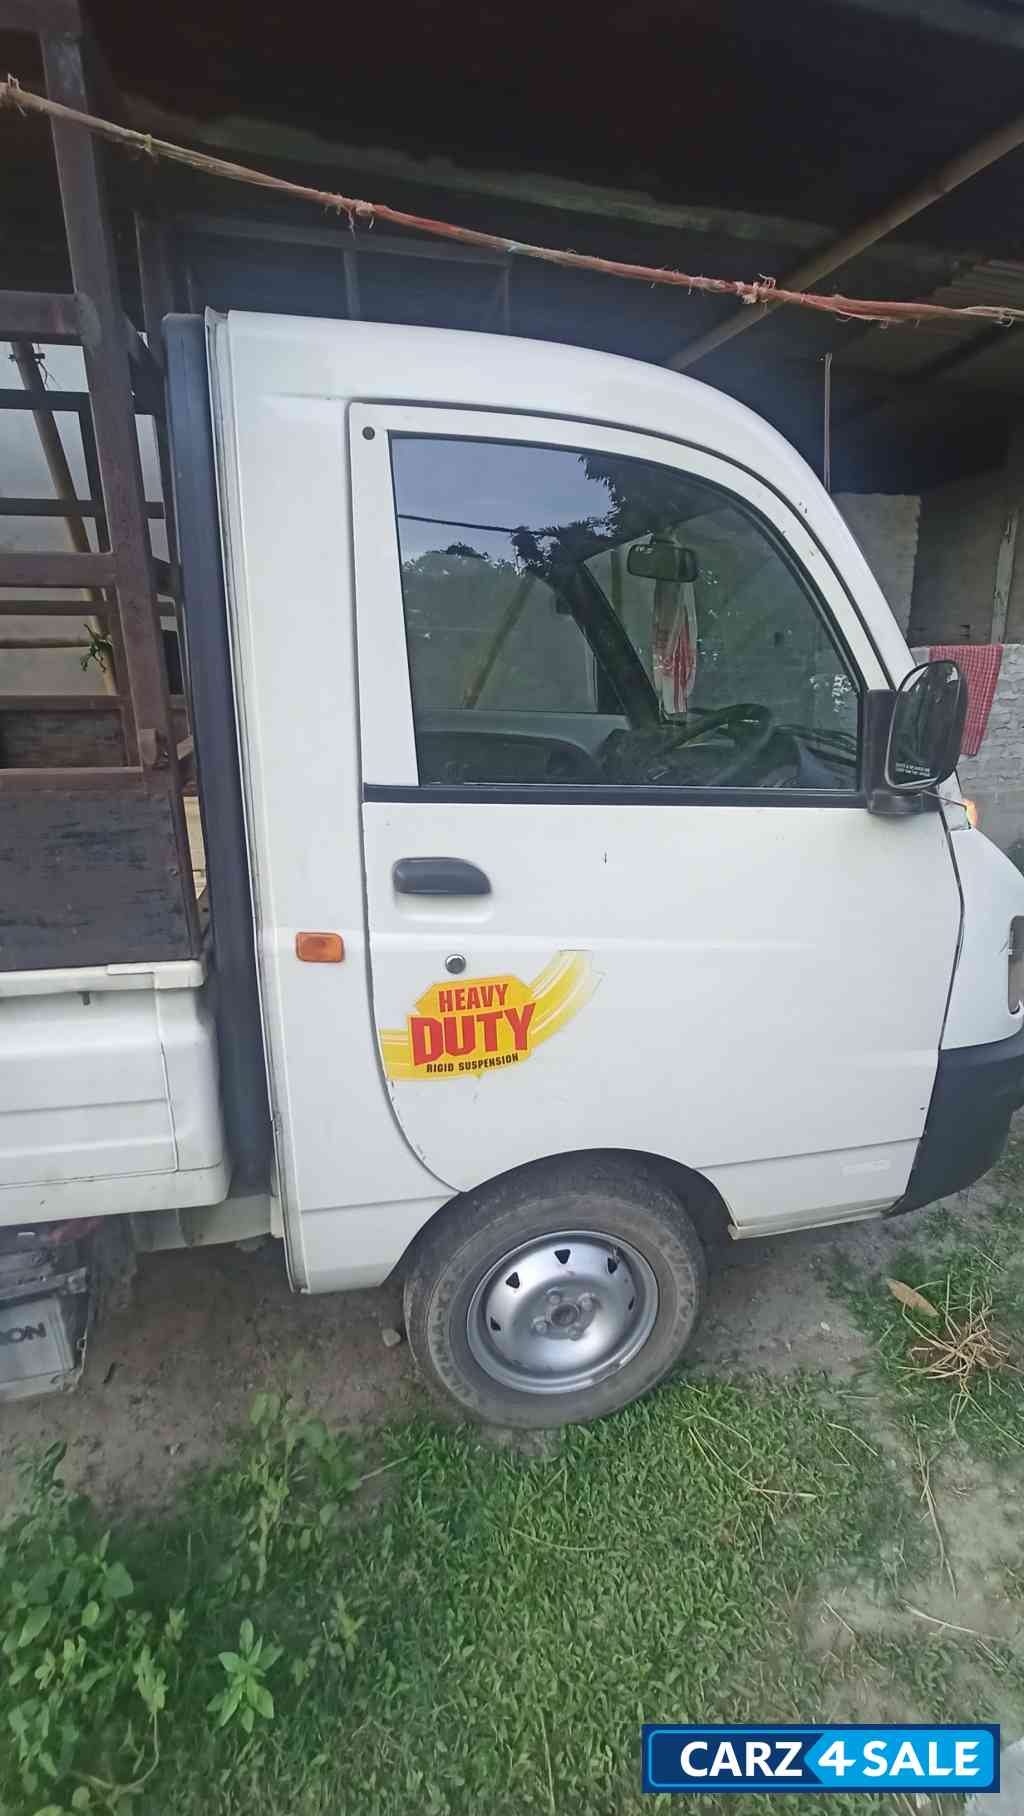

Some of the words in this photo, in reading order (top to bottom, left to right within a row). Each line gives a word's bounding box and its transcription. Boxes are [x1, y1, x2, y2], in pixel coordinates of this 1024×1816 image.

[438, 984, 509, 1012] HEAVY
[410, 1002, 536, 1066] DUTY
[426, 1063, 455, 1073] RIGID
[458, 1053, 519, 1071] SUSPENSION
